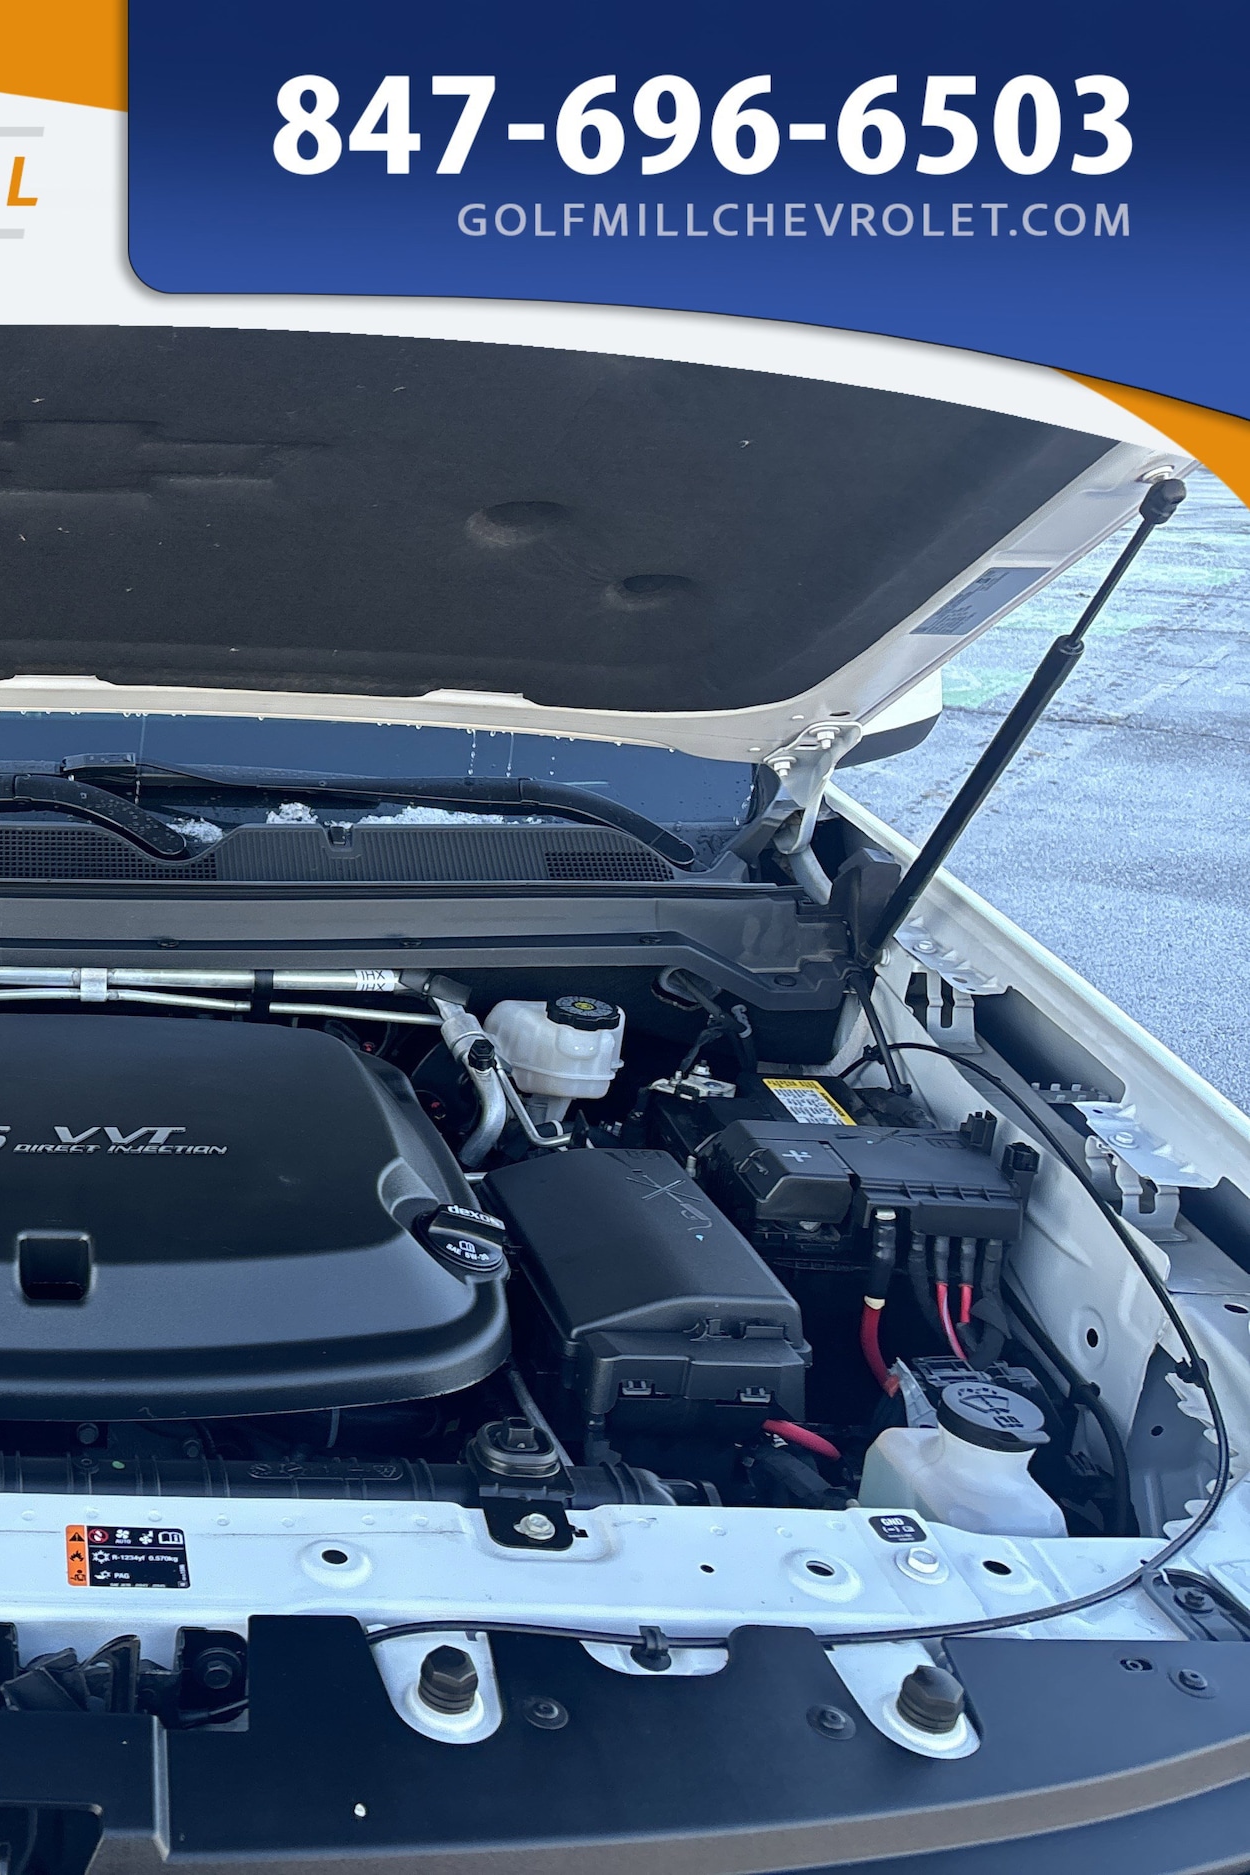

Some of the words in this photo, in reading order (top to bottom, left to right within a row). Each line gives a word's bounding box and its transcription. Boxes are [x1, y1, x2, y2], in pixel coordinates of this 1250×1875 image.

[53, 1126, 187, 1145] VVT
[13, 1143, 101, 1154] DIRECT
[107, 1145, 228, 1155] INJECTION
